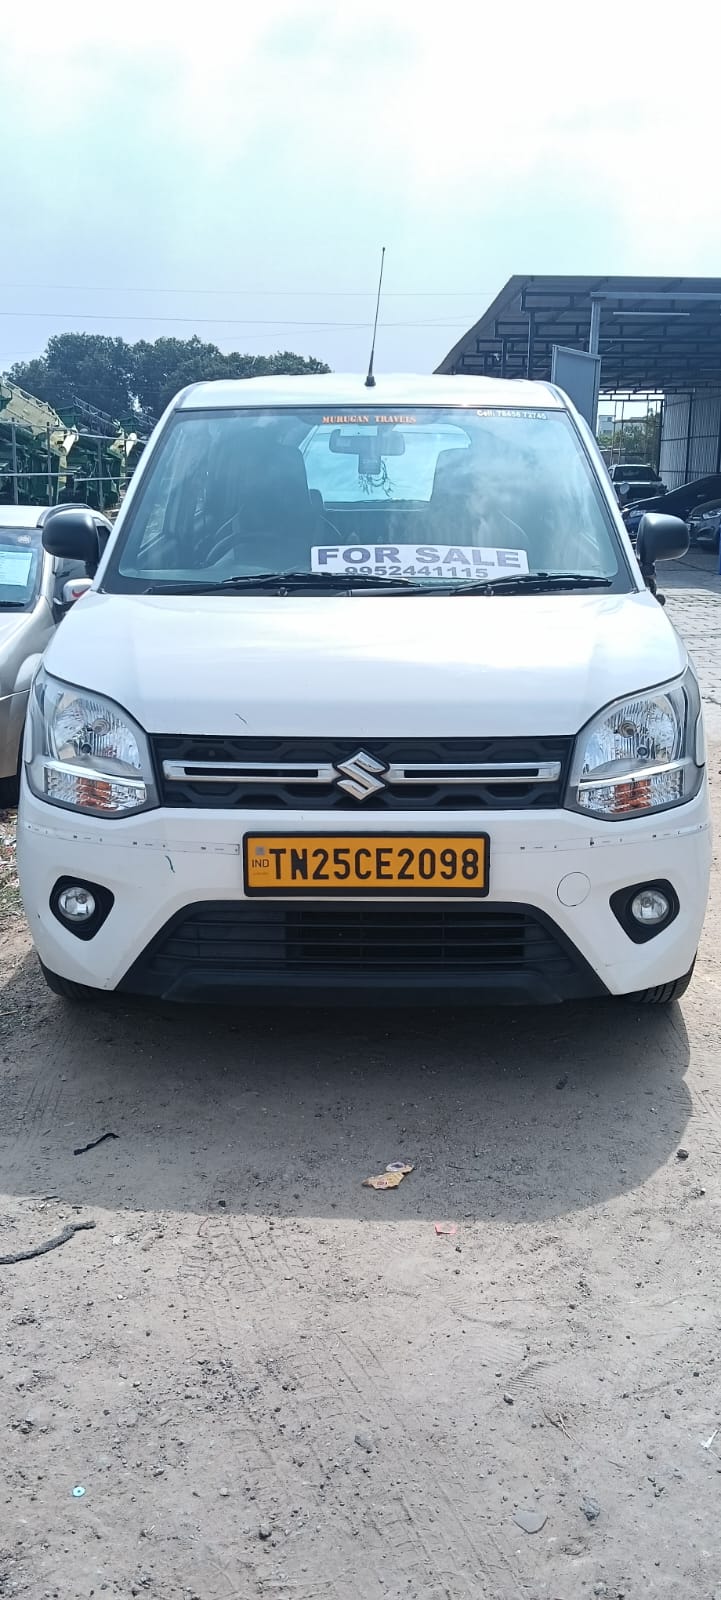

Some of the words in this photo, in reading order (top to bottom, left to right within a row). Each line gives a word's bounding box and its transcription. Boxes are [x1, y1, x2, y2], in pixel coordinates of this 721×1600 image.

[322, 415, 369, 424] MURUGAN
[374, 415, 417, 424] TRAVELS
[317, 547, 402, 565] FOR
[415, 547, 521, 568] SALE
[344, 565, 489, 578] 9952441115
[251, 858, 270, 868] IND
[268, 848, 479, 880] TN25CE2098
